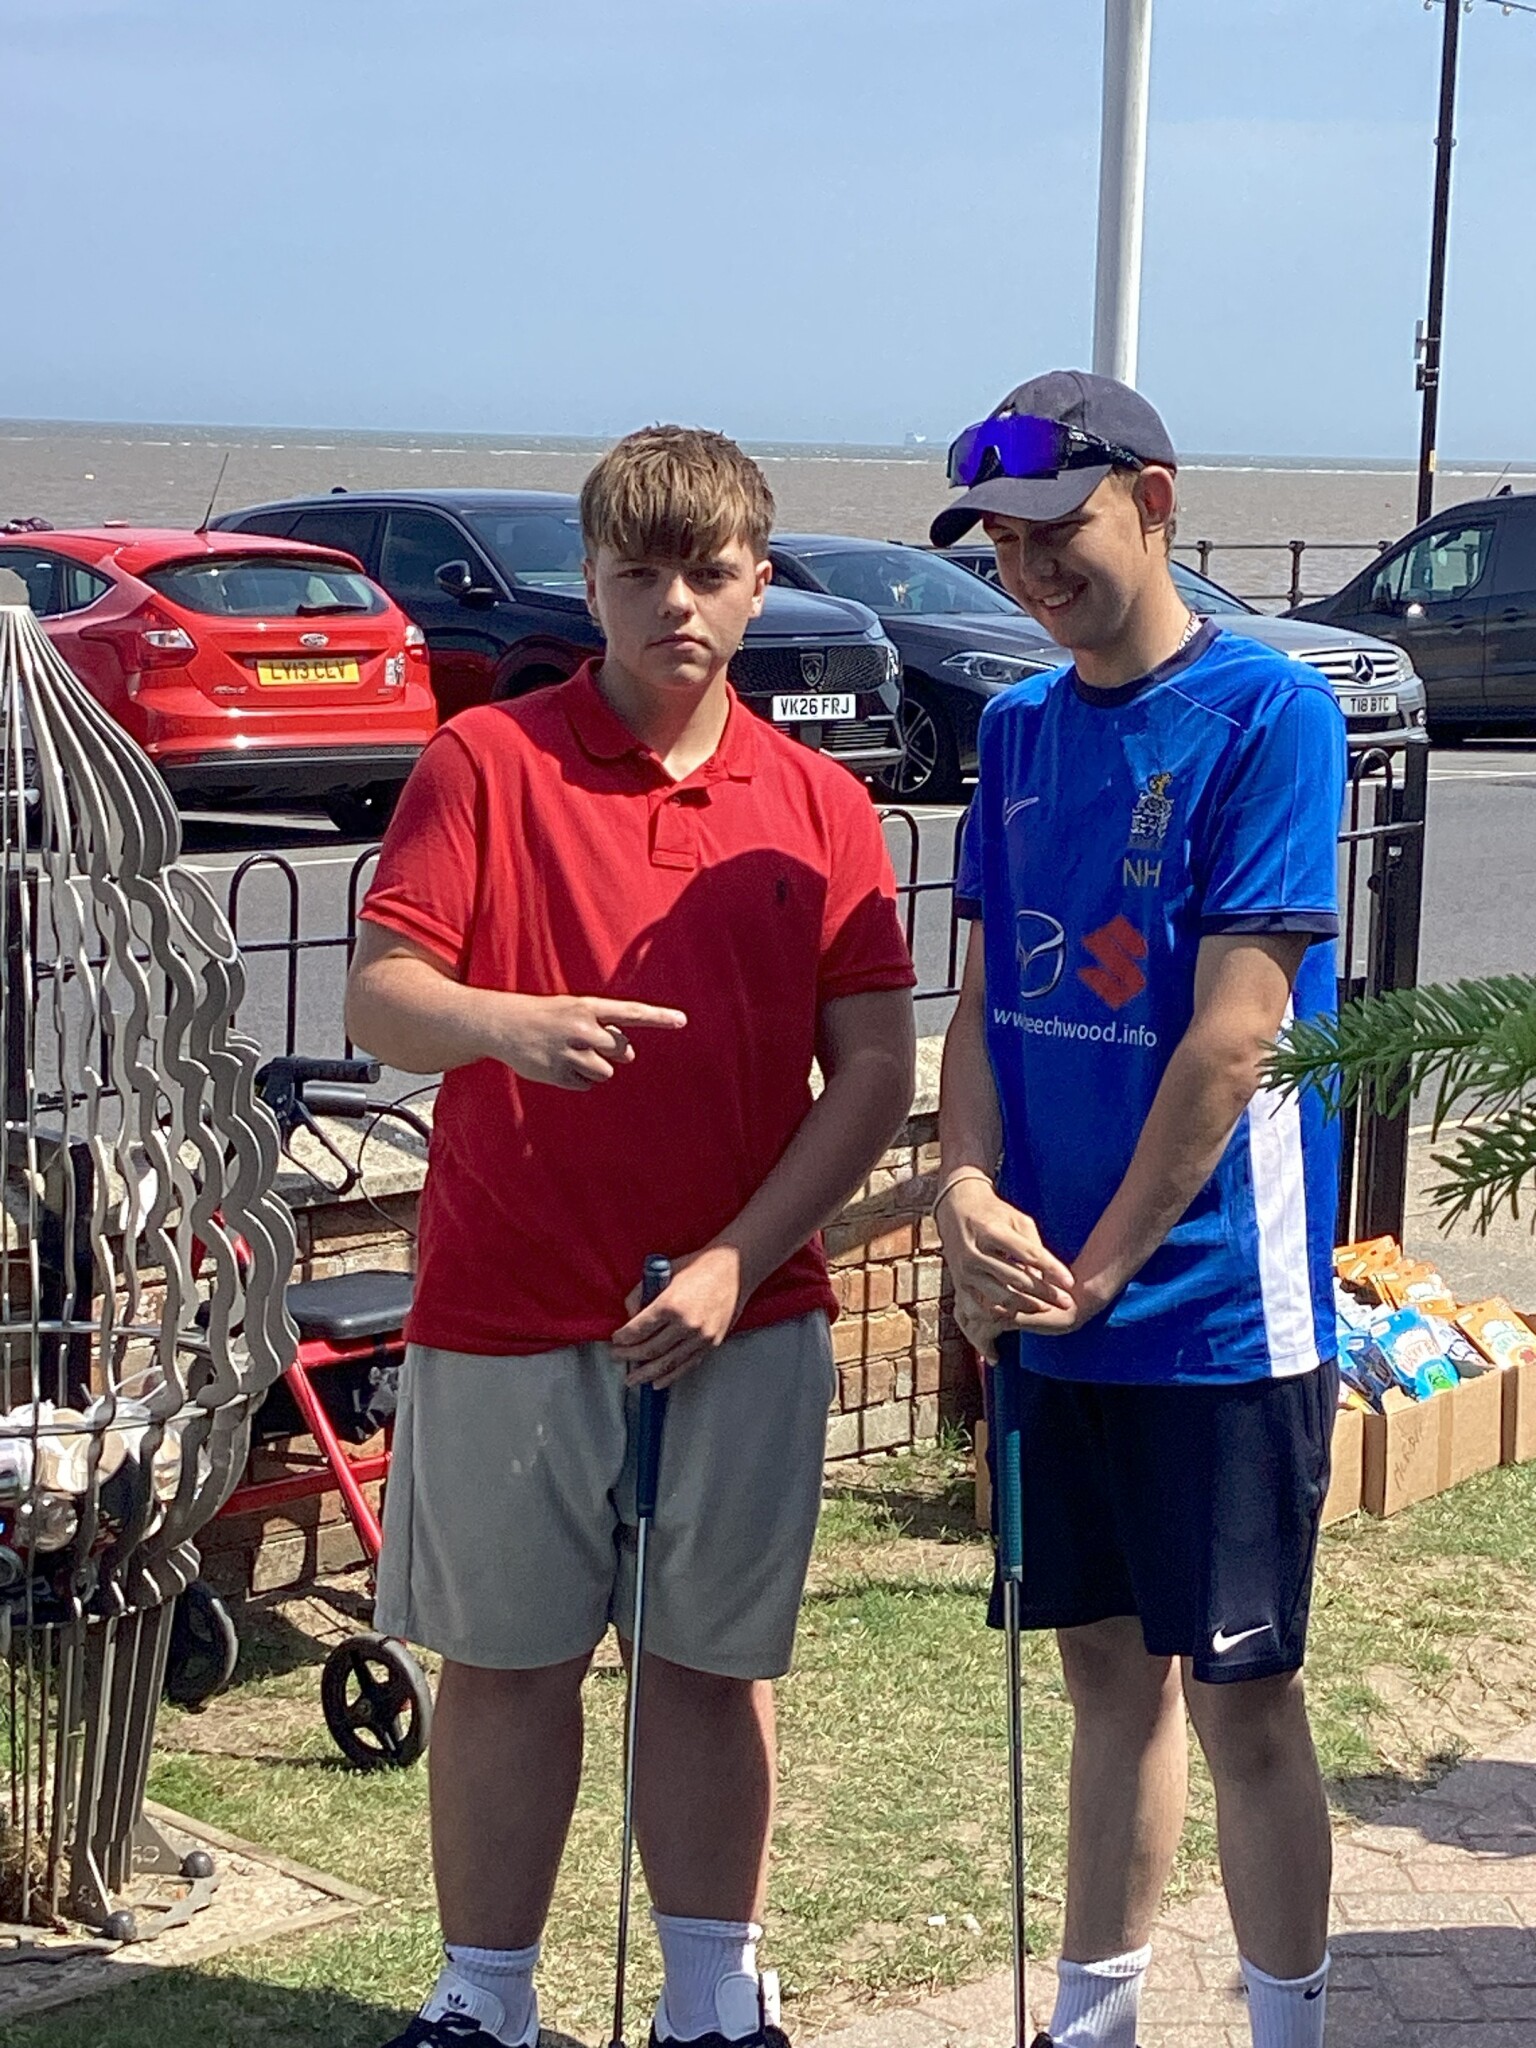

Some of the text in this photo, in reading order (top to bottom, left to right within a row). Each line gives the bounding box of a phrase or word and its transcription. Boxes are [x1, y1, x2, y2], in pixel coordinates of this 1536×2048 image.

[269, 661, 310, 680] LY13
[780, 697, 850, 716] VK26 FRJ
[1370, 696, 1390, 712] BTC
[1123, 857, 1163, 888] NH
